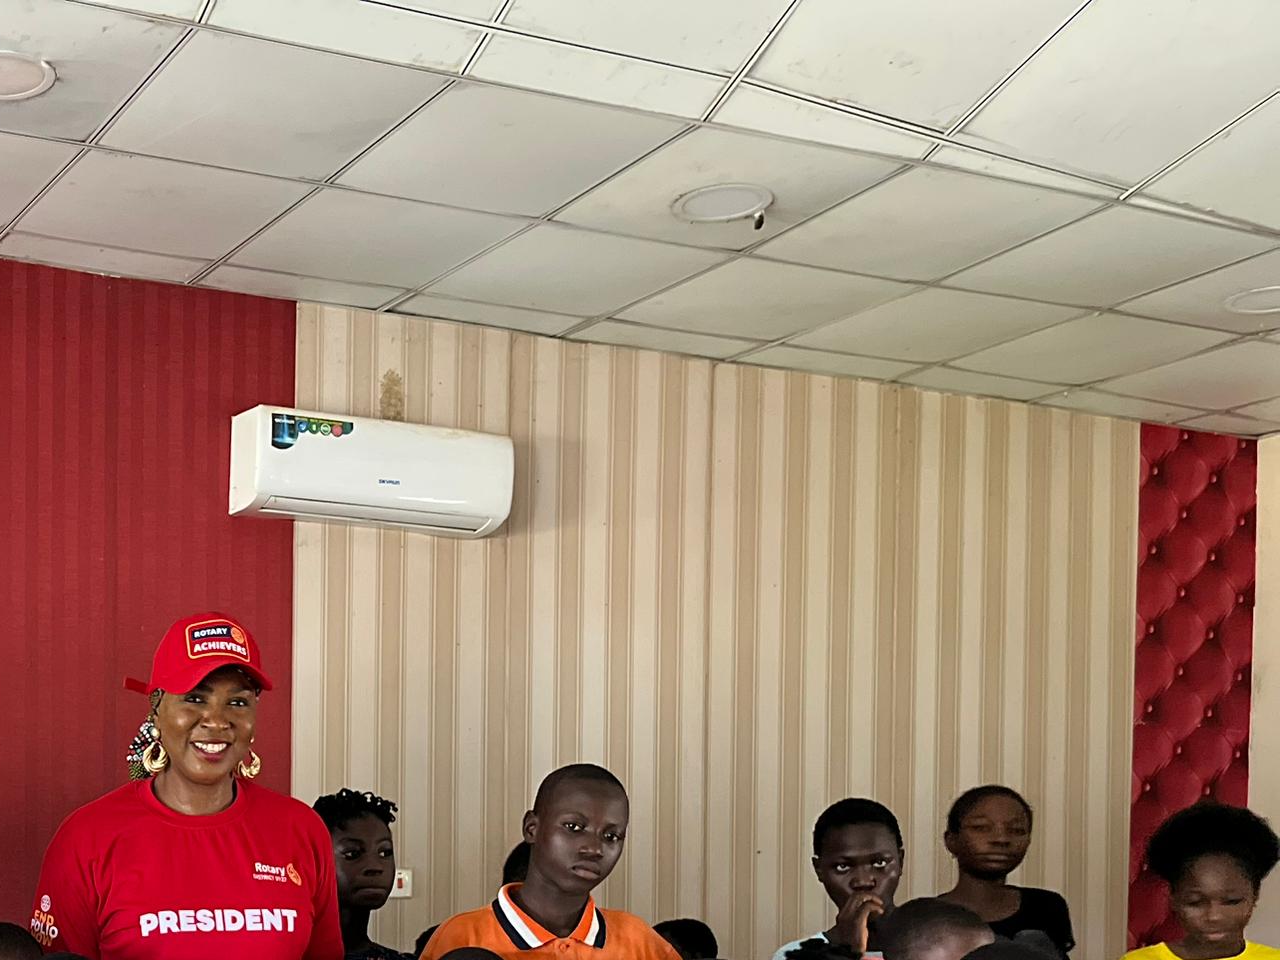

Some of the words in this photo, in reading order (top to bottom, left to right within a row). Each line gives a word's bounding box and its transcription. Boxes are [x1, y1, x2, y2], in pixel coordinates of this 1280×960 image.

[194, 628, 227, 638] ROTARY
[194, 641, 247, 655] ACHIEVERS
[255, 862, 285, 877] Rotary
[34, 909, 55, 927] END
[140, 908, 297, 937] PRESIDENT
[31, 918, 58, 938] POLIO
